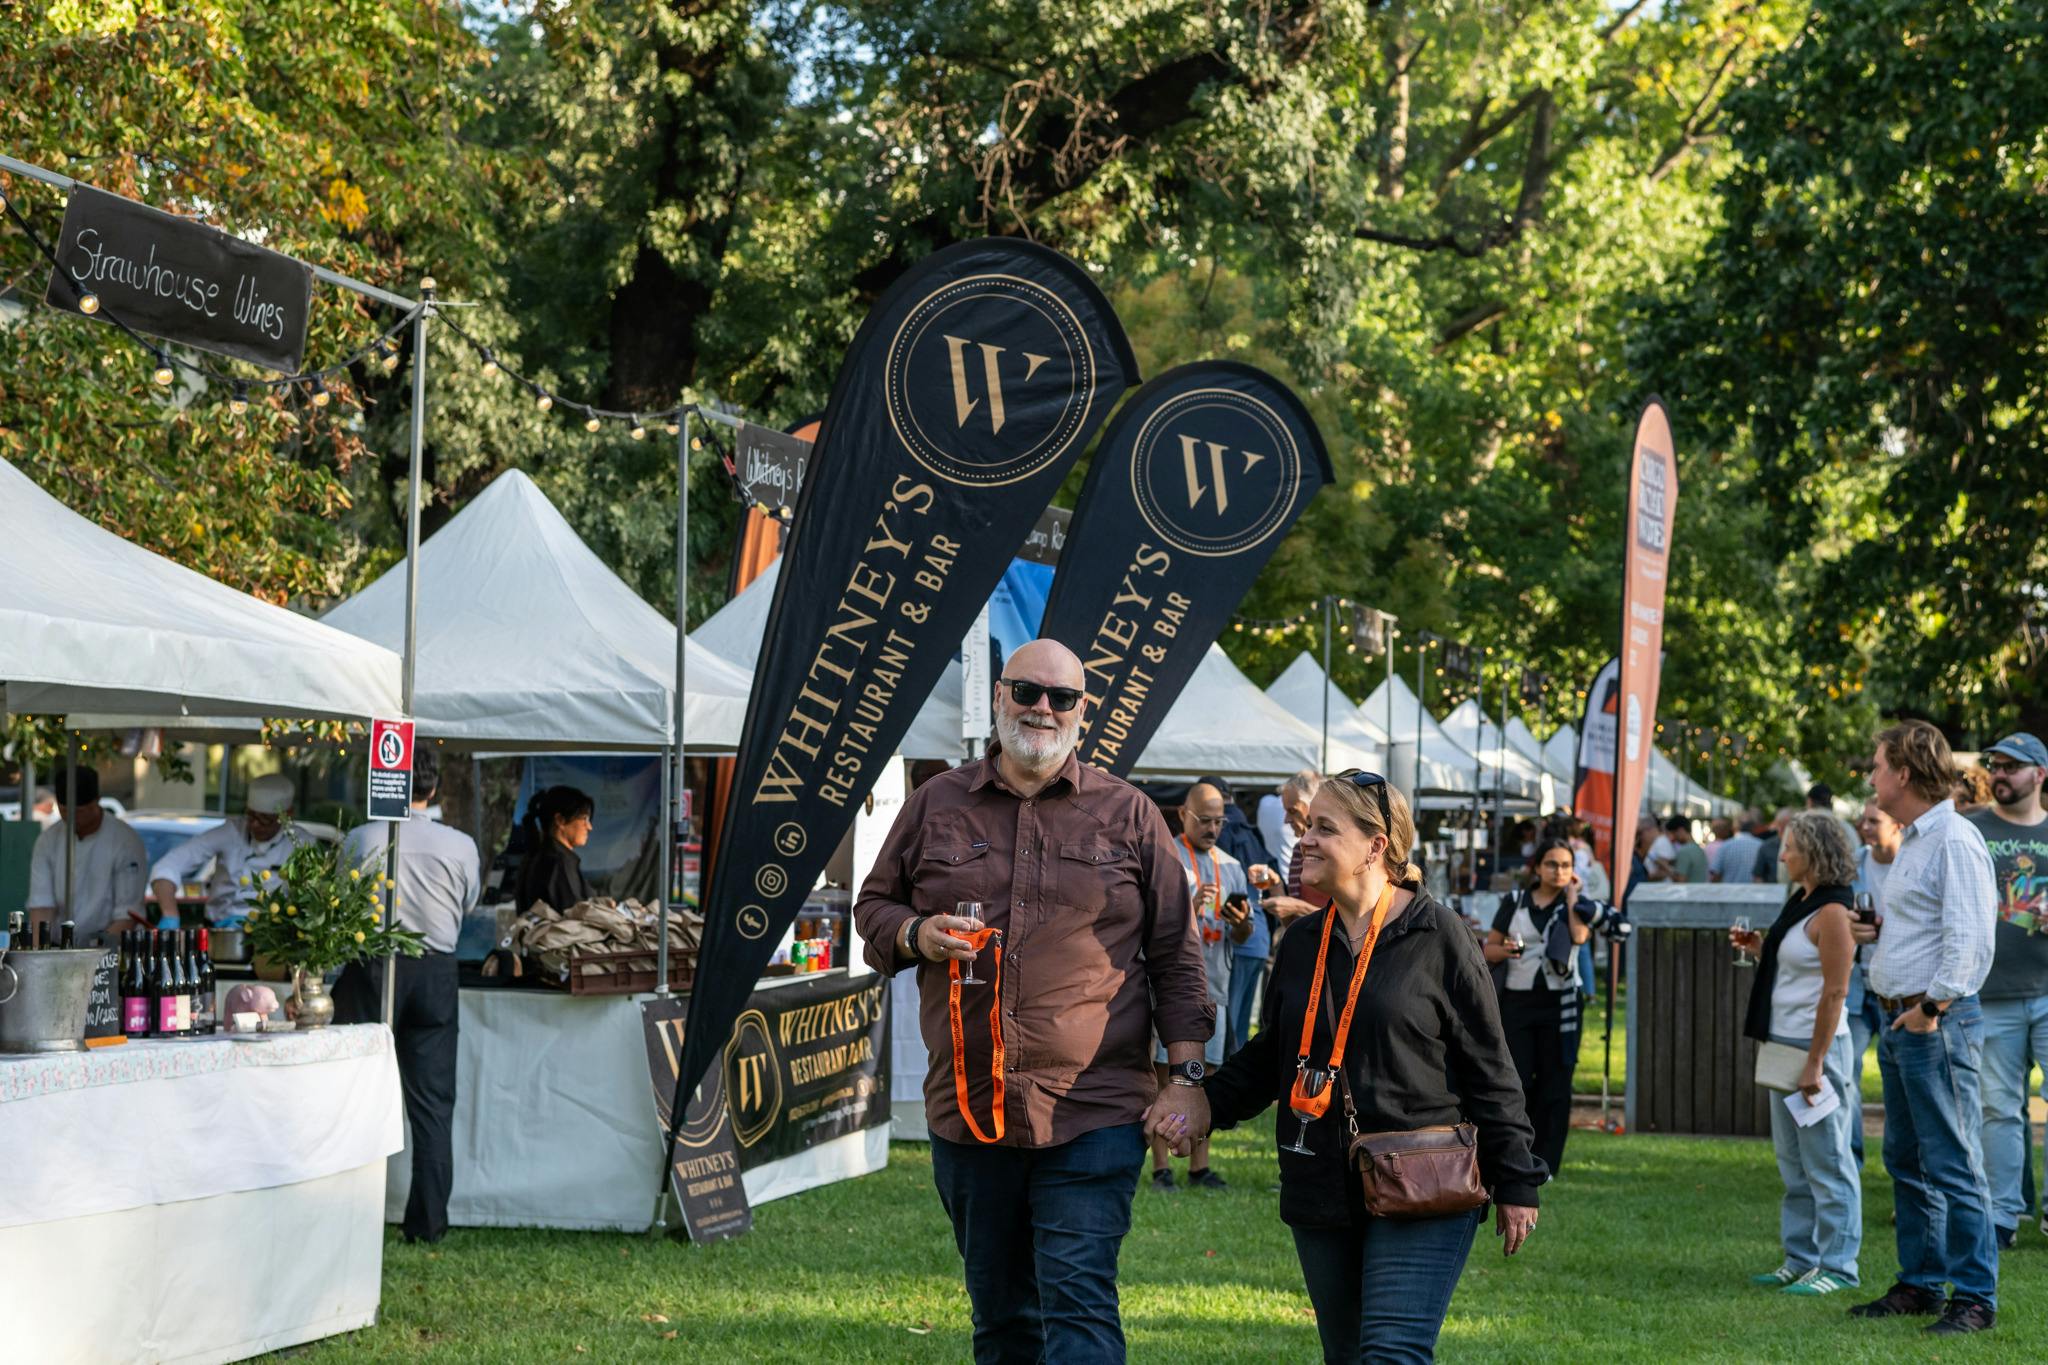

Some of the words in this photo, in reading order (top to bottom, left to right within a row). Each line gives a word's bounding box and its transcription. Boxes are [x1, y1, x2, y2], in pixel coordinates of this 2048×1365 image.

[72, 228, 220, 318] Strawhouse
[233, 274, 284, 341] Wines
[942, 334, 1052, 436] W
[1177, 434, 1266, 517] W
[914, 533, 962, 592] BAR
[752, 474, 935, 806] WHITNEY'S
[901, 602, 932, 624] &
[1153, 591, 1192, 639] BAR
[1141, 644, 1168, 664] &
[818, 629, 916, 807] RESTAURANT
[779, 985, 882, 1048] WHITNEY'S
